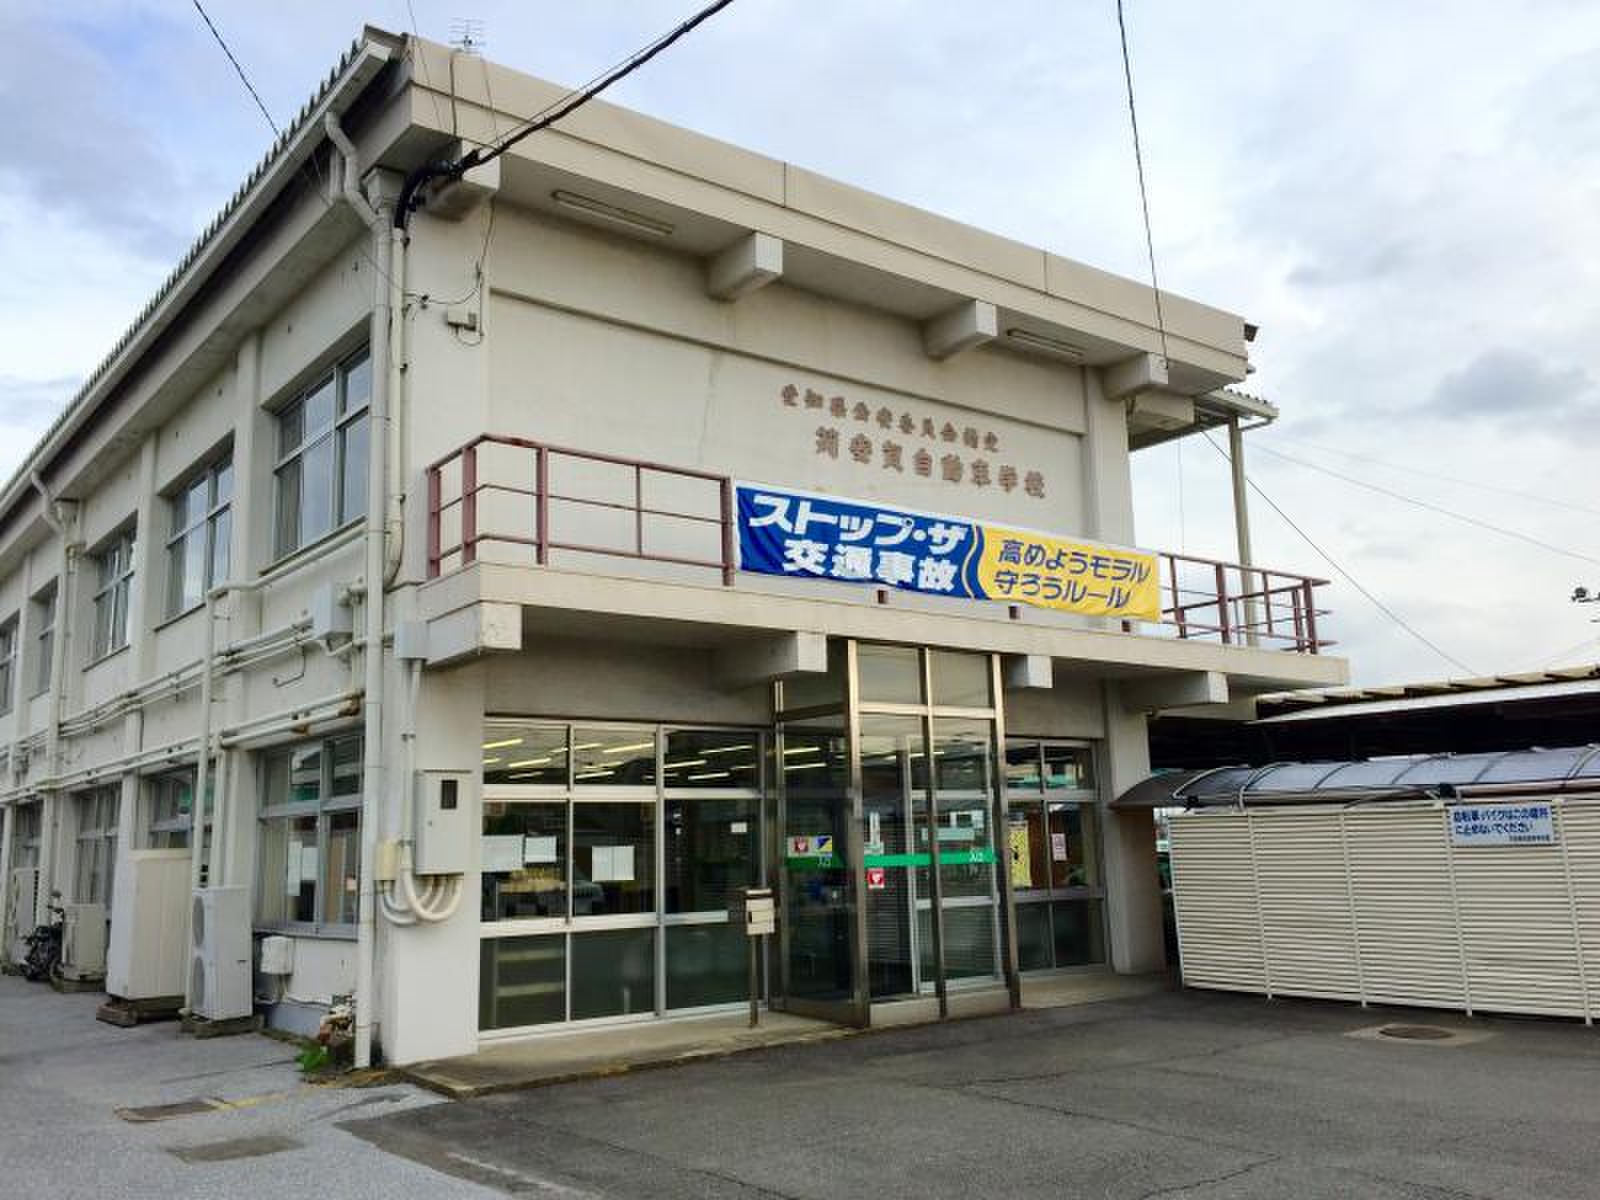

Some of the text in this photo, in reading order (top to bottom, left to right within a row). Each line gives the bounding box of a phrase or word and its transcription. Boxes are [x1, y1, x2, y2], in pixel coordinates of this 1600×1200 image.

[750, 494, 966, 556] ストップ・ザ
[783, 539, 958, 593] 交通事故
[999, 539, 1151, 582] 高めようモラル
[993, 569, 1132, 609] 守ろうルール
